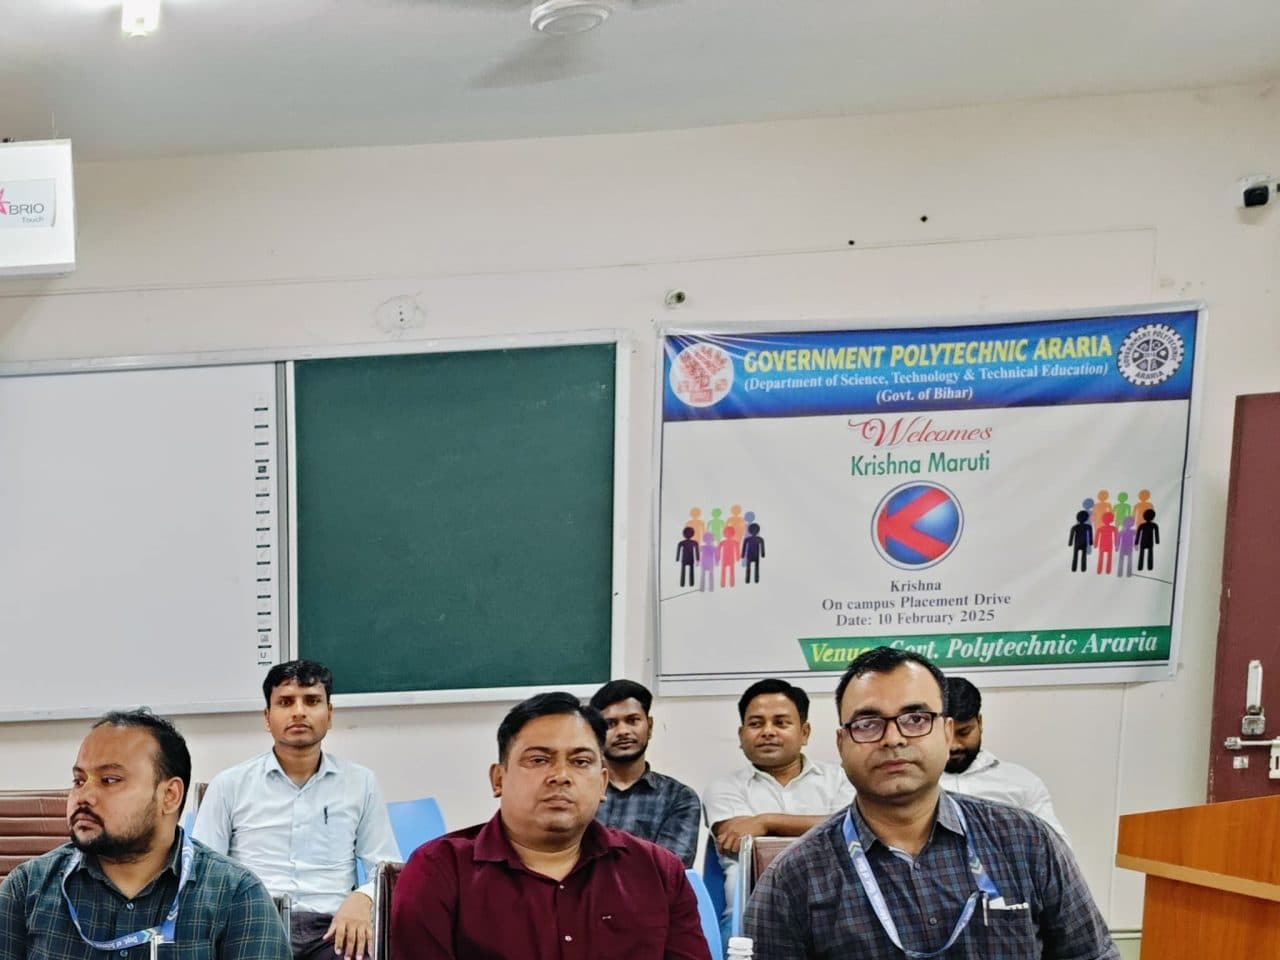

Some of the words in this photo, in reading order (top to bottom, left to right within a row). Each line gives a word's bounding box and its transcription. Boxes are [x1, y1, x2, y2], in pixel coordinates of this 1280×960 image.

[743, 346, 886, 373] GOVERNMENT
[889, 338, 1029, 367] POLYTECHNIC
[1033, 334, 1113, 361] ARARIA
[744, 375, 821, 392] (Department
[825, 374, 839, 387] of
[840, 373, 889, 386] Science,
[891, 370, 959, 385] Technology
[963, 368, 975, 381] &
[978, 365, 1038, 380] Technical
[1041, 362, 1108, 377] Education)
[876, 389, 914, 405] (Govt.
[917, 387, 931, 400] of
[934, 386, 974, 401] Bihar)
[847, 415, 993, 447] Welcomes
[850, 452, 921, 476] Krishna
[927, 449, 990, 473] Maruti
[890, 580, 942, 593] Krishna
[822, 598, 843, 611] On
[847, 599, 895, 612] campus
[900, 595, 968, 609] Placement
[974, 592, 1011, 606] Drive
[836, 614, 872, 627] Date:
[878, 613, 892, 626] 10
[897, 611, 954, 626] February
[960, 609, 995, 622] 2025
[946, 633, 1078, 664] Polytechnic
[1080, 630, 1158, 654] Araria
